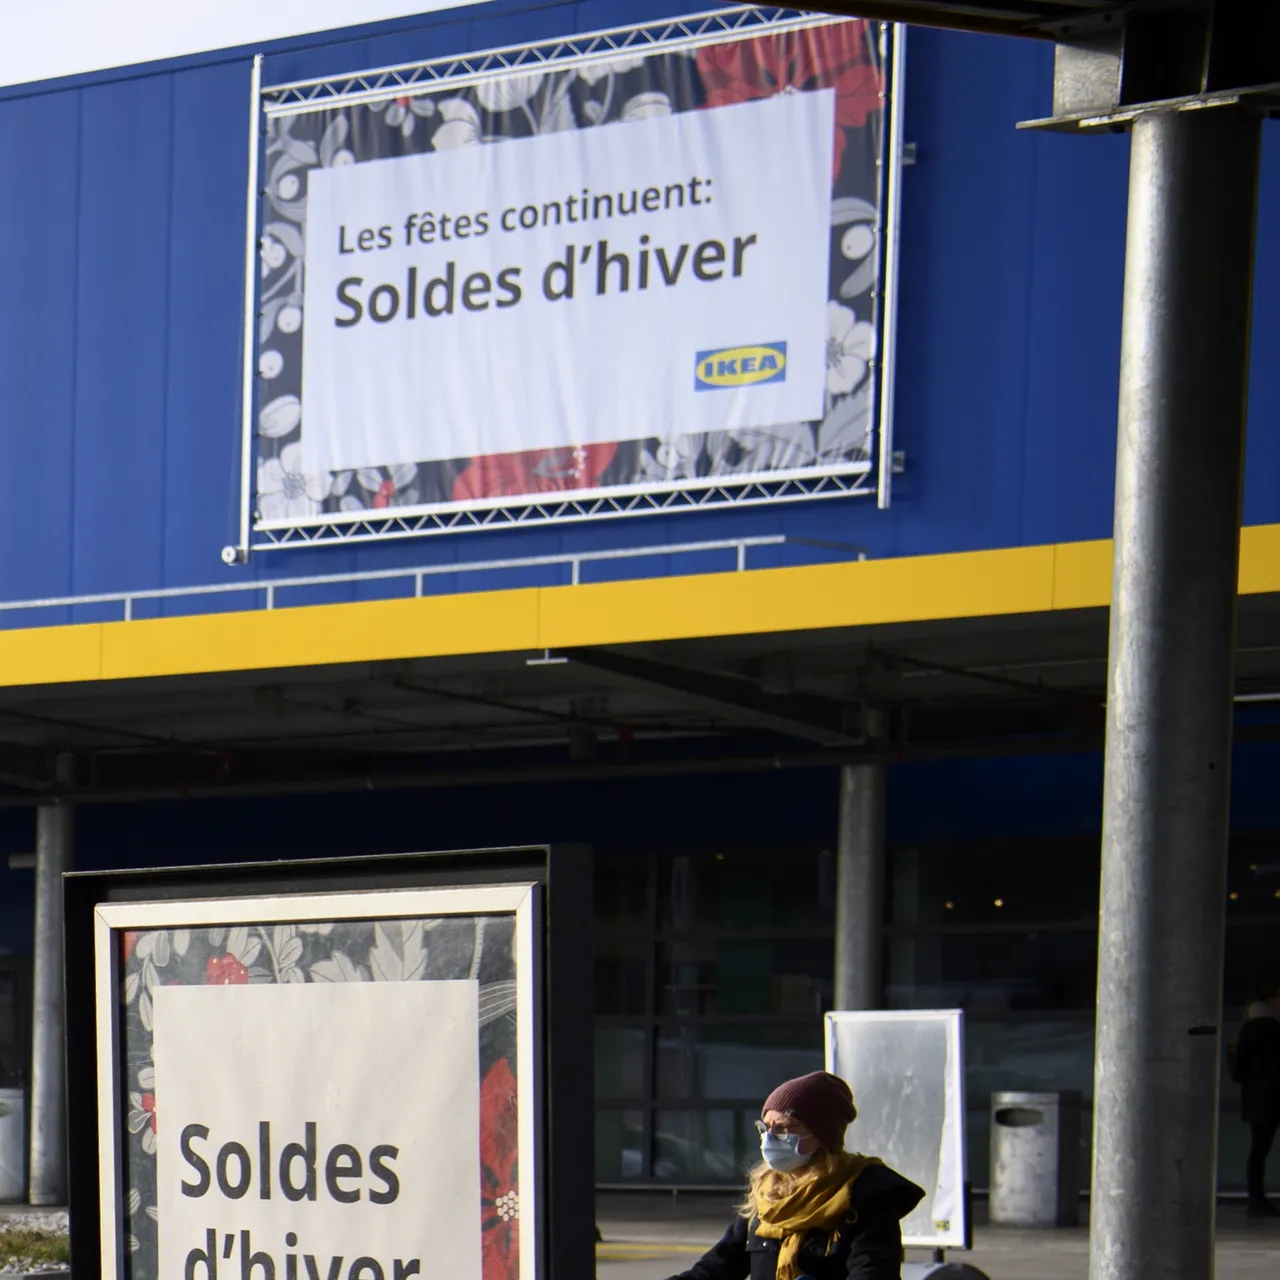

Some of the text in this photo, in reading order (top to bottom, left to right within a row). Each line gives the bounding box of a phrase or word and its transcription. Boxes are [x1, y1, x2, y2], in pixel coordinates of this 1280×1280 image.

[337, 174, 714, 255] Les fêtes continuent:
[333, 231, 758, 329] Soldes d'hiver
[704, 354, 778, 378] IKEA
[178, 1120, 401, 1206] Soldes
